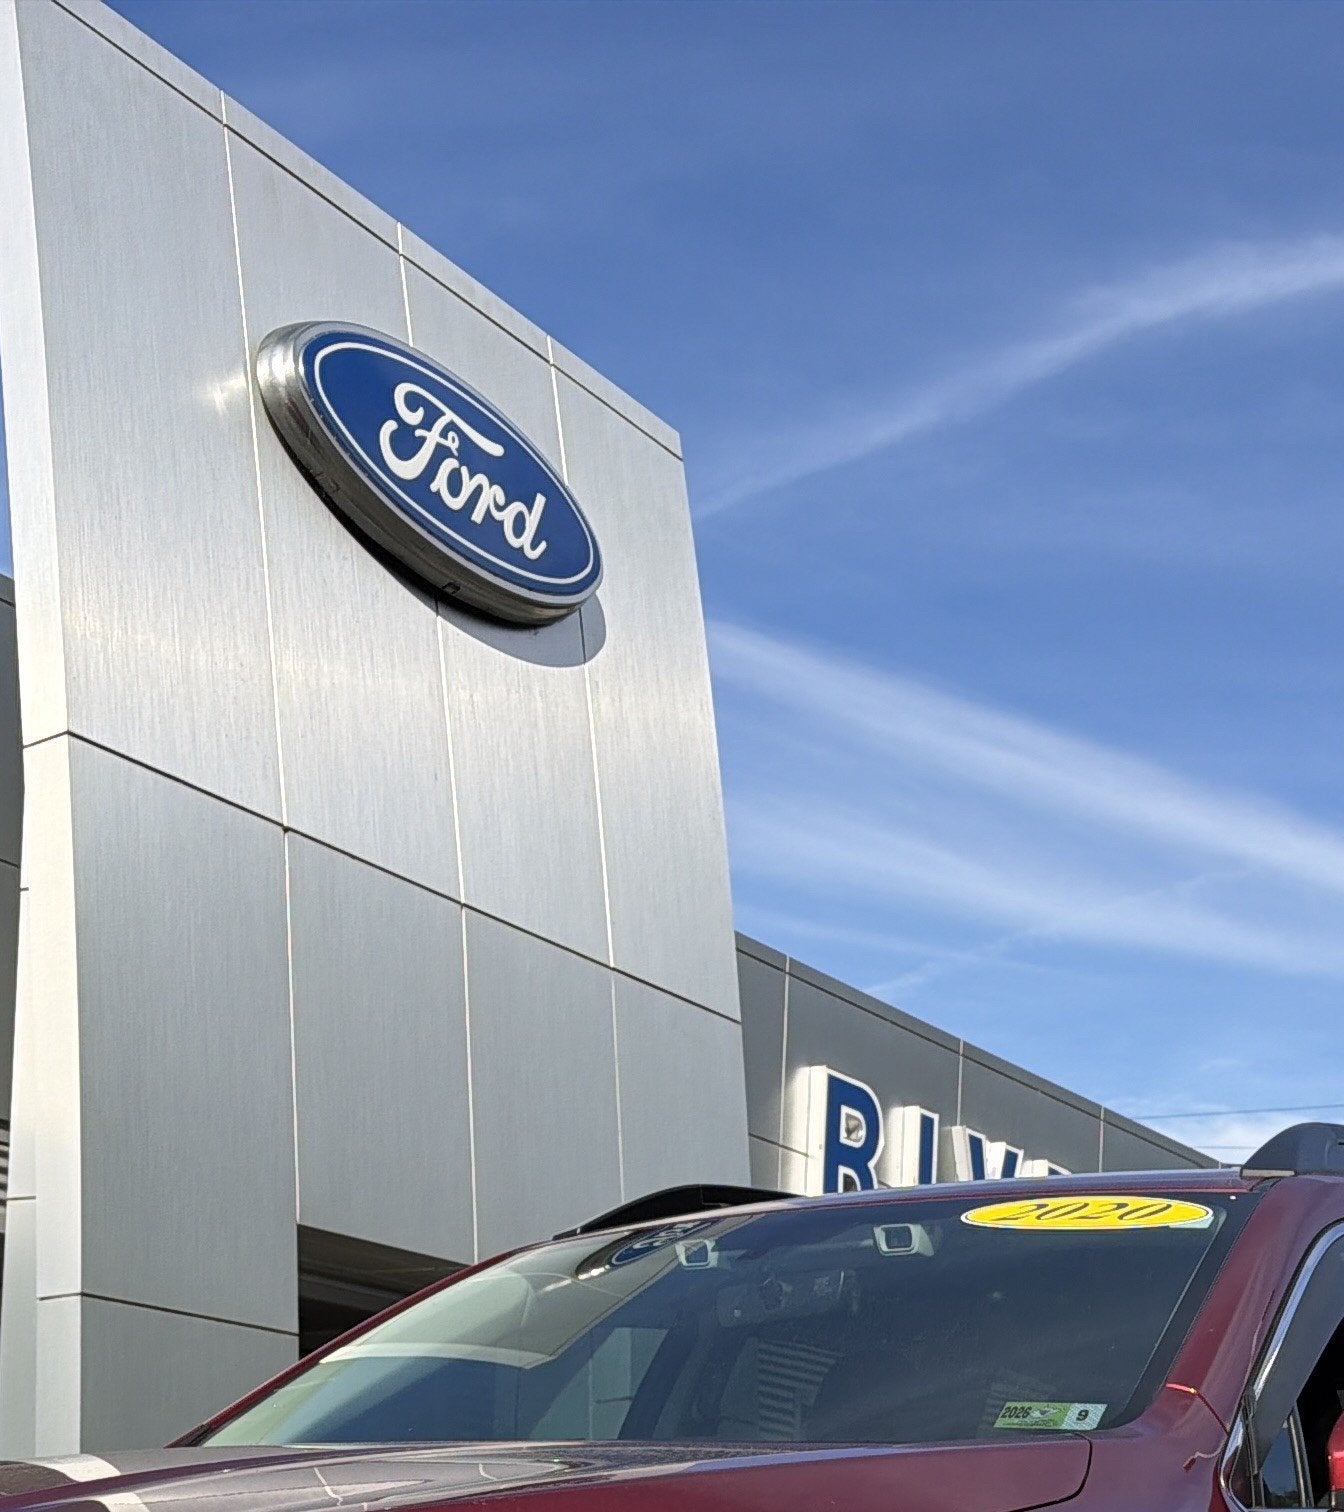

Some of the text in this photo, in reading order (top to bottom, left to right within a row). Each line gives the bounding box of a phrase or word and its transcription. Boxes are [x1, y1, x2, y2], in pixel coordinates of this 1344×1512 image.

[379, 382, 548, 560] Ford
[804, 1064, 1072, 1198] RIV
[993, 1202, 1173, 1221] 2020
[1000, 1405, 1033, 1420] 2026
[1076, 1408, 1090, 1422] 9
